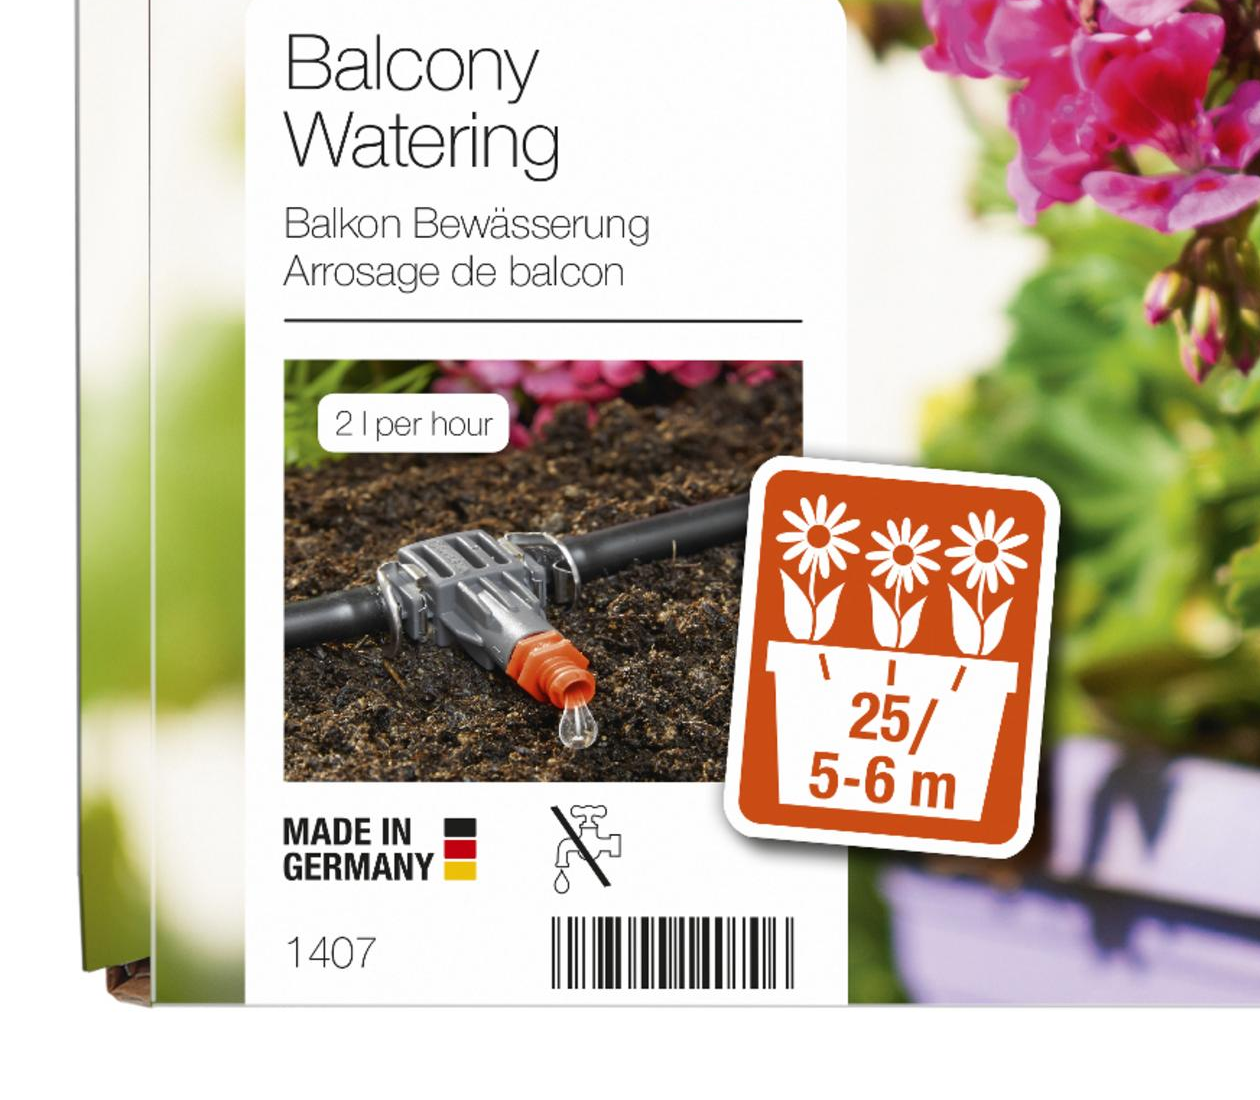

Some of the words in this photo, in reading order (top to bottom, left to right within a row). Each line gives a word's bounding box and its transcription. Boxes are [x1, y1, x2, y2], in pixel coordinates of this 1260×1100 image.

[288, 33, 540, 105] Balcony
[282, 110, 559, 183] Watering
[285, 206, 401, 239] Balkon
[414, 206, 650, 248] Bewässerung
[282, 254, 440, 295] Arrosage
[451, 254, 497, 288] de
[510, 254, 624, 288] balcon
[335, 410, 353, 437] 2
[376, 415, 423, 442] per
[431, 410, 494, 437] hour
[848, 691, 939, 757] 25/
[808, 751, 896, 805] 5-6
[911, 772, 955, 809] m
[282, 816, 372, 846] MADE
[381, 817, 412, 846] IN
[282, 851, 435, 882] GERMANY
[287, 935, 377, 970] 1407
